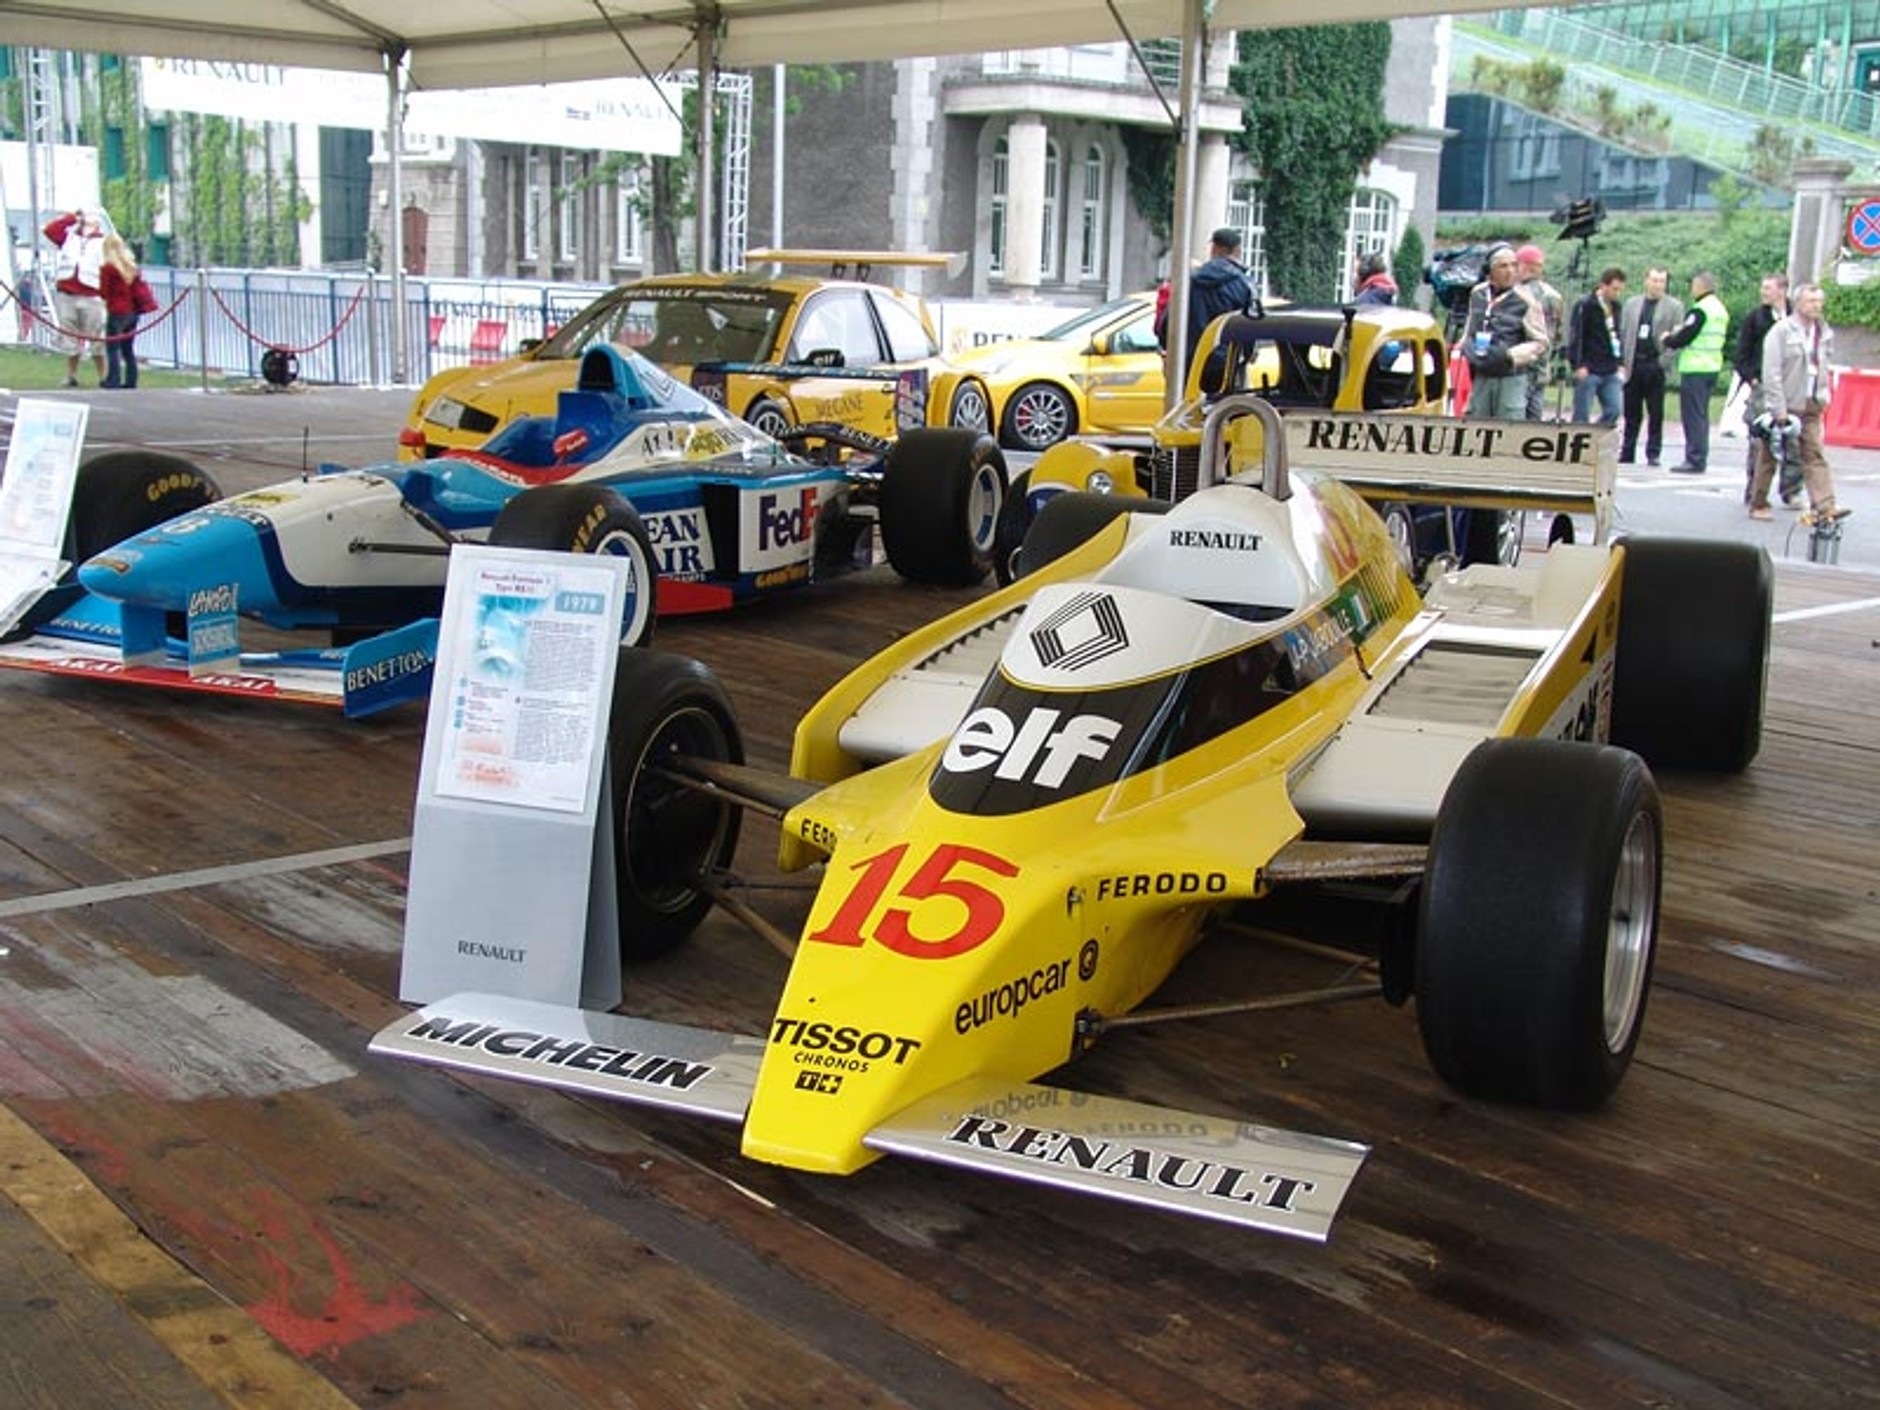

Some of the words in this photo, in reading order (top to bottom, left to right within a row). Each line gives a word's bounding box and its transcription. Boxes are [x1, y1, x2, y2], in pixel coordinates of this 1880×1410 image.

[813, 353, 836, 366] elf
[1306, 418, 1502, 459] RENAULT
[1522, 431, 1594, 464] elf
[1169, 530, 1263, 552] RENAULT
[942, 706, 1124, 790] elf
[808, 843, 1021, 960] 15
[1097, 872, 1228, 901] FERODO
[457, 939, 528, 963] RENAULT
[954, 957, 1072, 1036] europcar
[408, 1016, 714, 1091] MICHELIN
[771, 1017, 922, 1066] TISSOT
[793, 1051, 871, 1074] CHRONOS
[945, 1115, 1314, 1212] RENAULT
